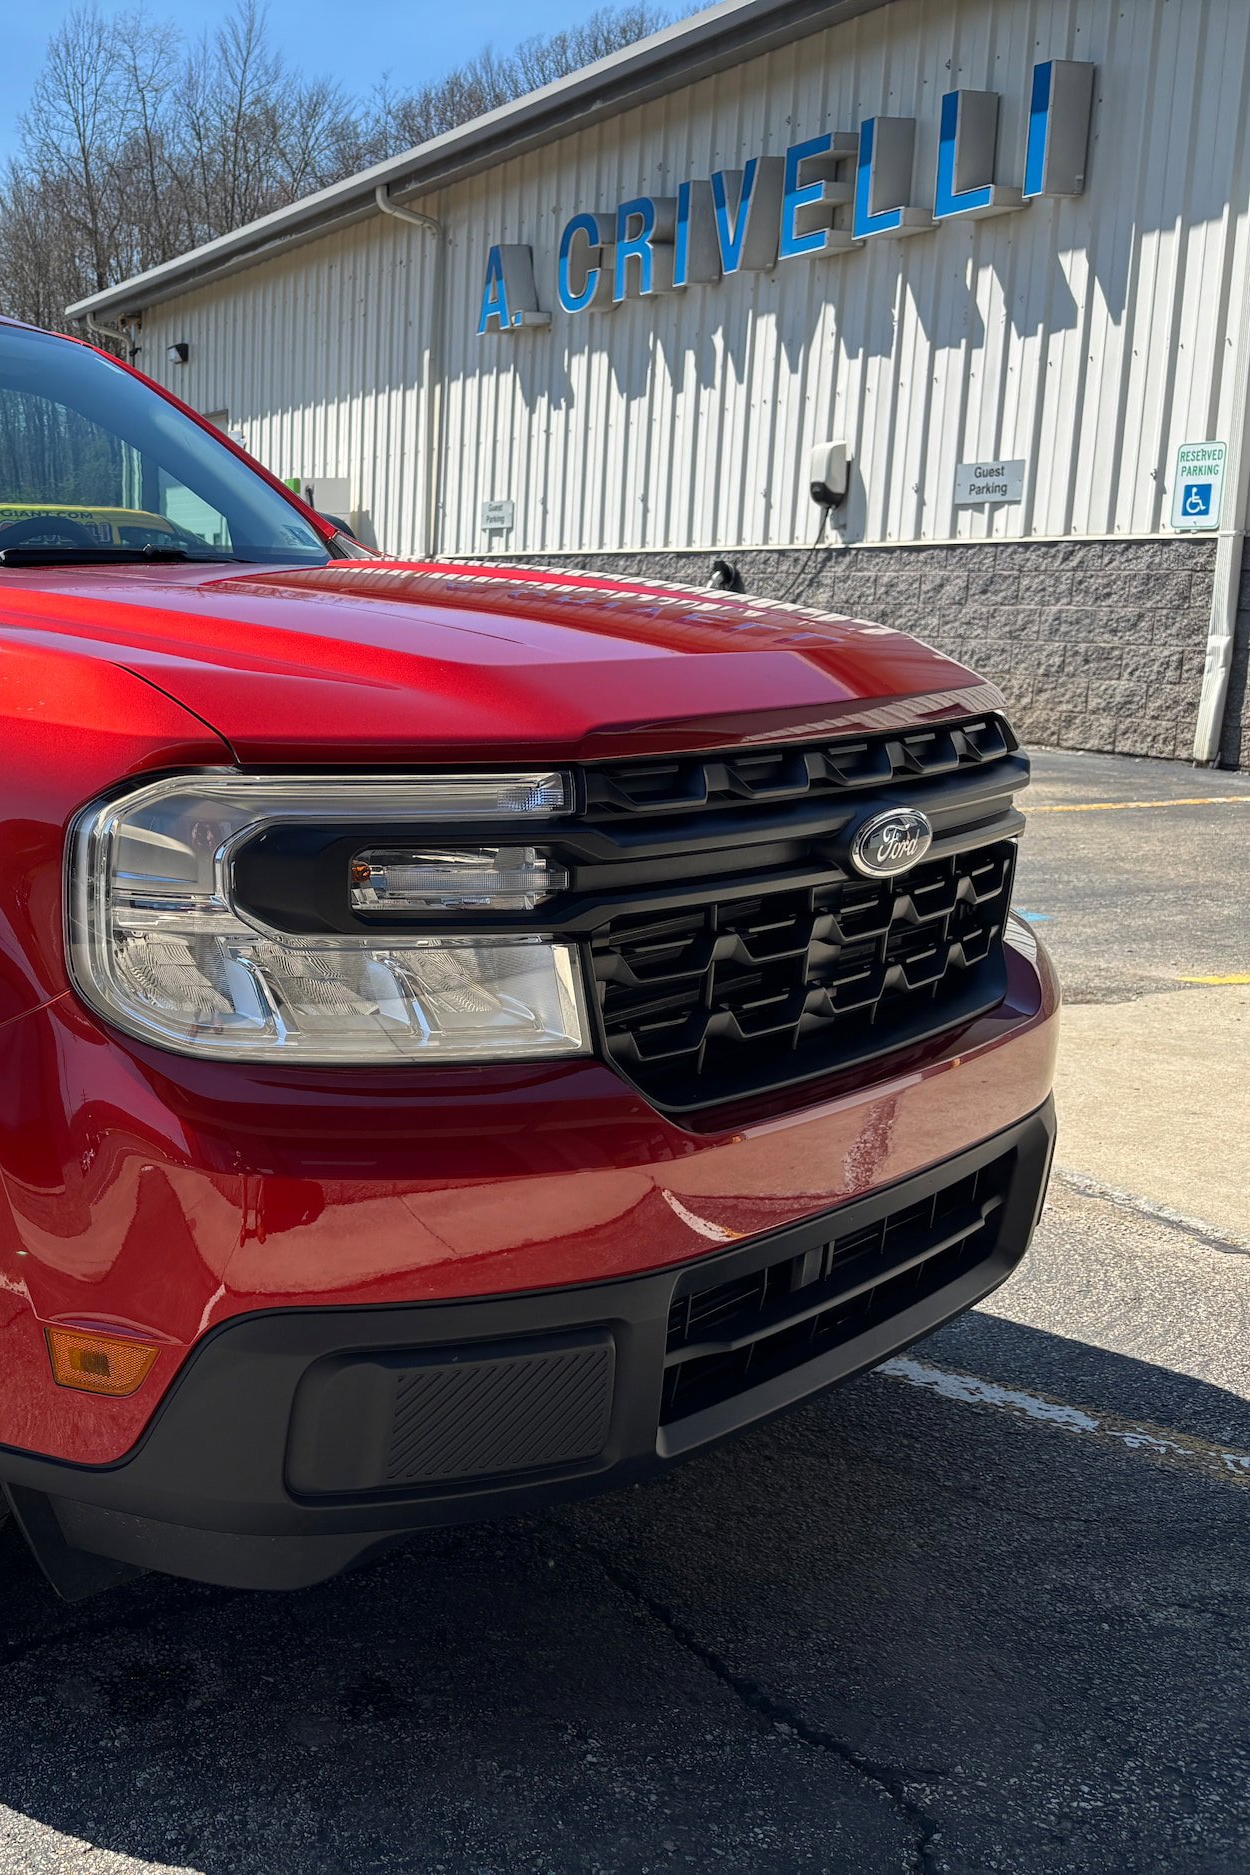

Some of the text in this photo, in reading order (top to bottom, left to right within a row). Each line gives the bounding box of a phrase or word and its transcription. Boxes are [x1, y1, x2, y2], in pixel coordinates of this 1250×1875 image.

[558, 60, 1080, 314] CRIVELLI
[1180, 448, 1224, 463] RESERVED
[974, 466, 1005, 478] Guest
[1181, 464, 1220, 477] PARKING
[968, 482, 1008, 496] Parking
[877, 823, 921, 863] Ford
